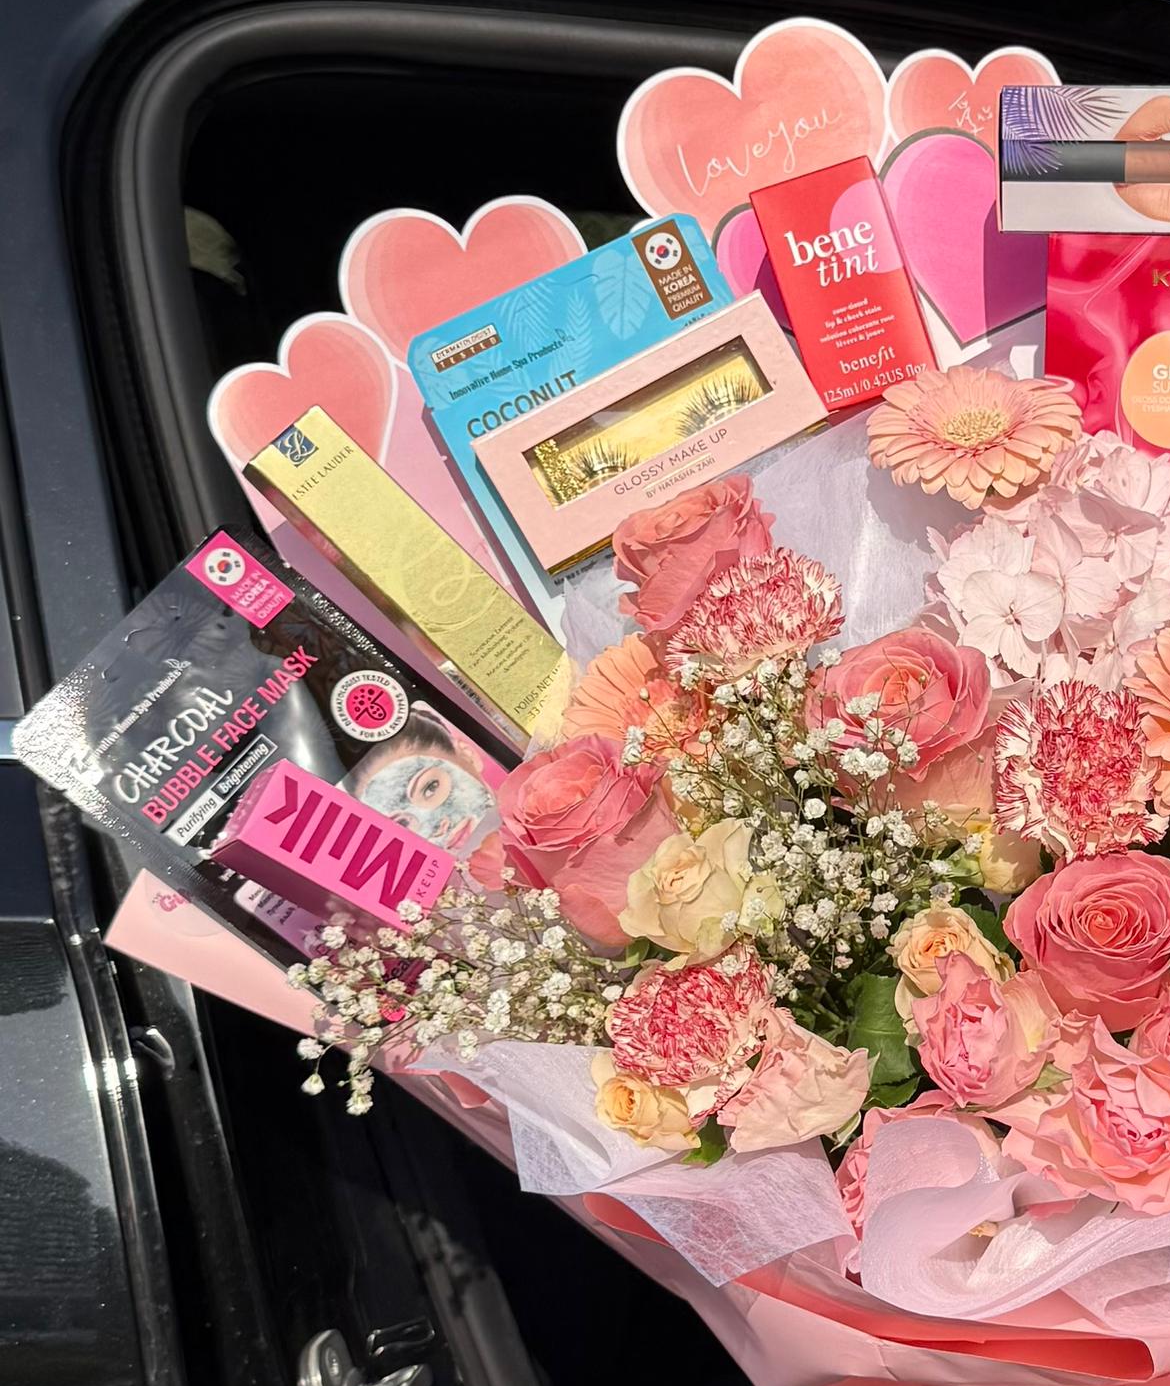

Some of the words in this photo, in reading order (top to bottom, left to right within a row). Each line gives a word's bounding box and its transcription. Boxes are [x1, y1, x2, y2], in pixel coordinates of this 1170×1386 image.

[784, 220, 875, 267] bene
[658, 268, 682, 286] MADE
[682, 264, 693, 273] IN
[663, 273, 697, 295] KOREA
[816, 244, 879, 287] tint
[672, 292, 704, 312] QUALITY
[440, 337, 497, 368] TESTED
[449, 376, 491, 400] Innovative
[511, 358, 528, 370] Spa
[527, 340, 564, 364] Products
[839, 345, 896, 375] benefit
[317, 445, 354, 478] LAUDER
[614, 462, 665, 495] GLOSSY
[669, 440, 707, 466] MAKE
[709, 428, 727, 444] UP
[646, 488, 656, 498] BY
[696, 457, 716, 472] ZAKI
[239, 578, 270, 606] KOREA
[362, 675, 390, 686] TESTED
[113, 686, 233, 804] CHARCOAL
[141, 744, 223, 826] BUBBLE
[211, 696, 268, 752] FACE
[256, 645, 319, 705] MASK
[176, 796, 219, 838] Purifying
[219, 742, 269, 795] Brightening
[415, 859, 440, 905] KEUP
